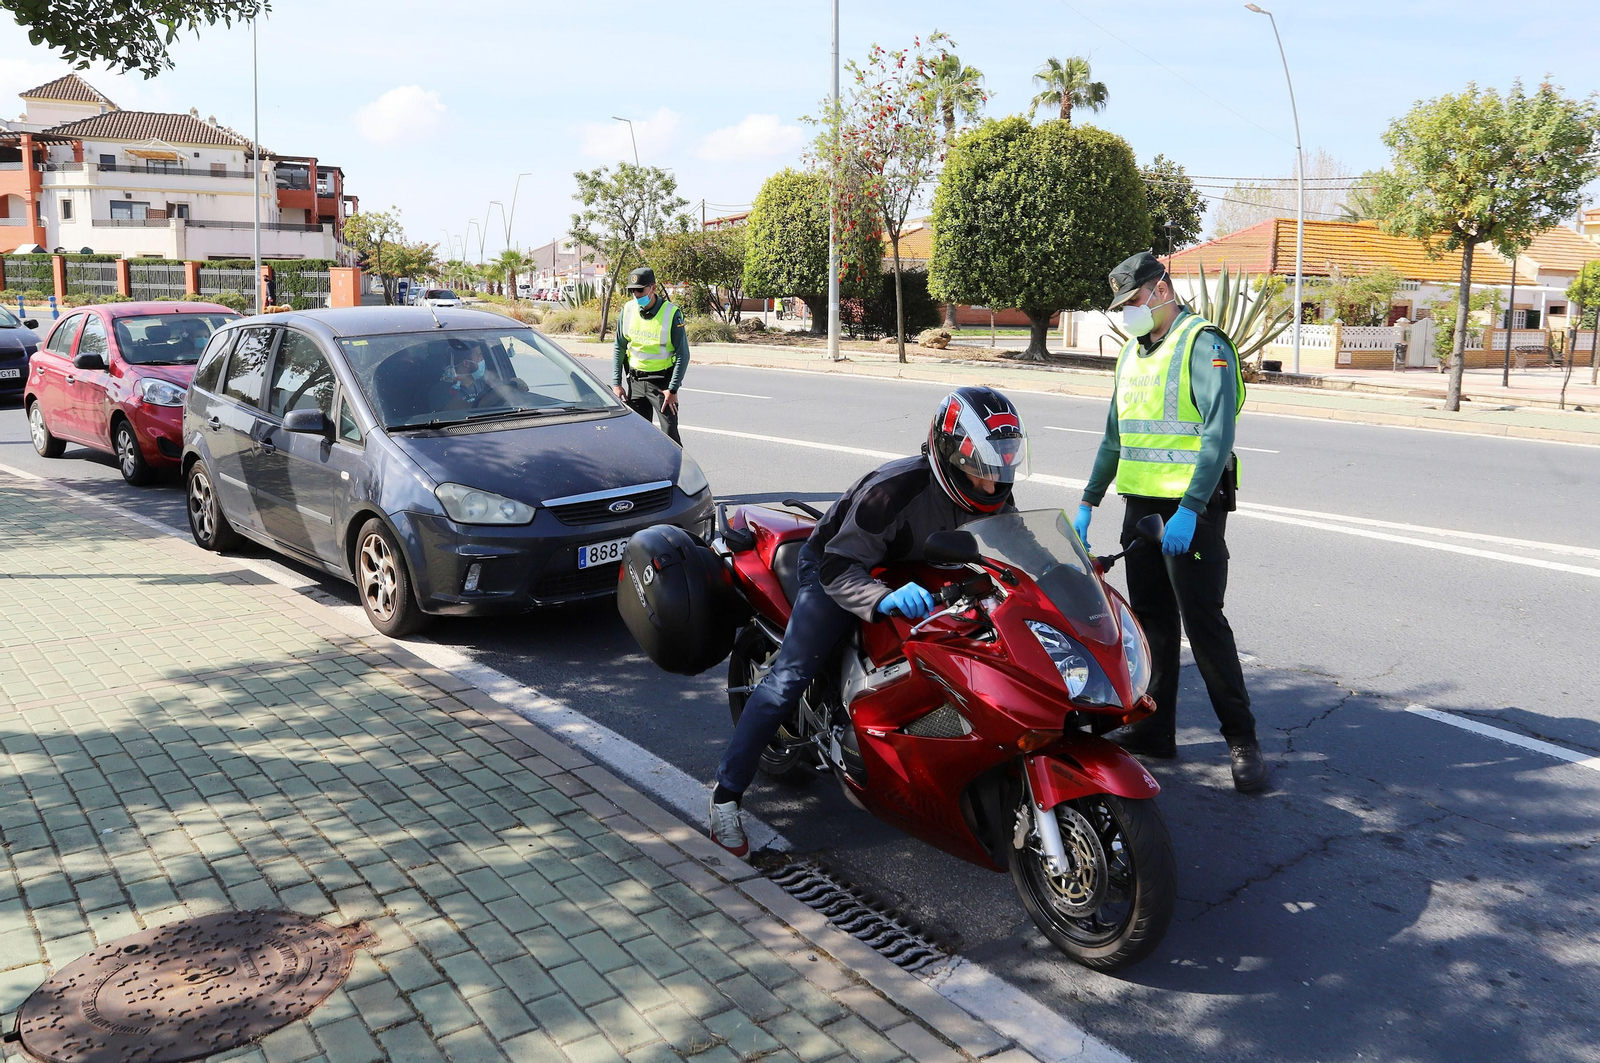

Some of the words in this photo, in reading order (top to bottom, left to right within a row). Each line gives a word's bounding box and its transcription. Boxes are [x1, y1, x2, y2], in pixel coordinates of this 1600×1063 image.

[629, 328, 659, 339] GUARDIA
[634, 336, 651, 344] CIVIL
[1120, 374, 1161, 388] GUARDIA
[1123, 391, 1148, 404] CIVIL
[1088, 611, 1110, 620] HONDA
